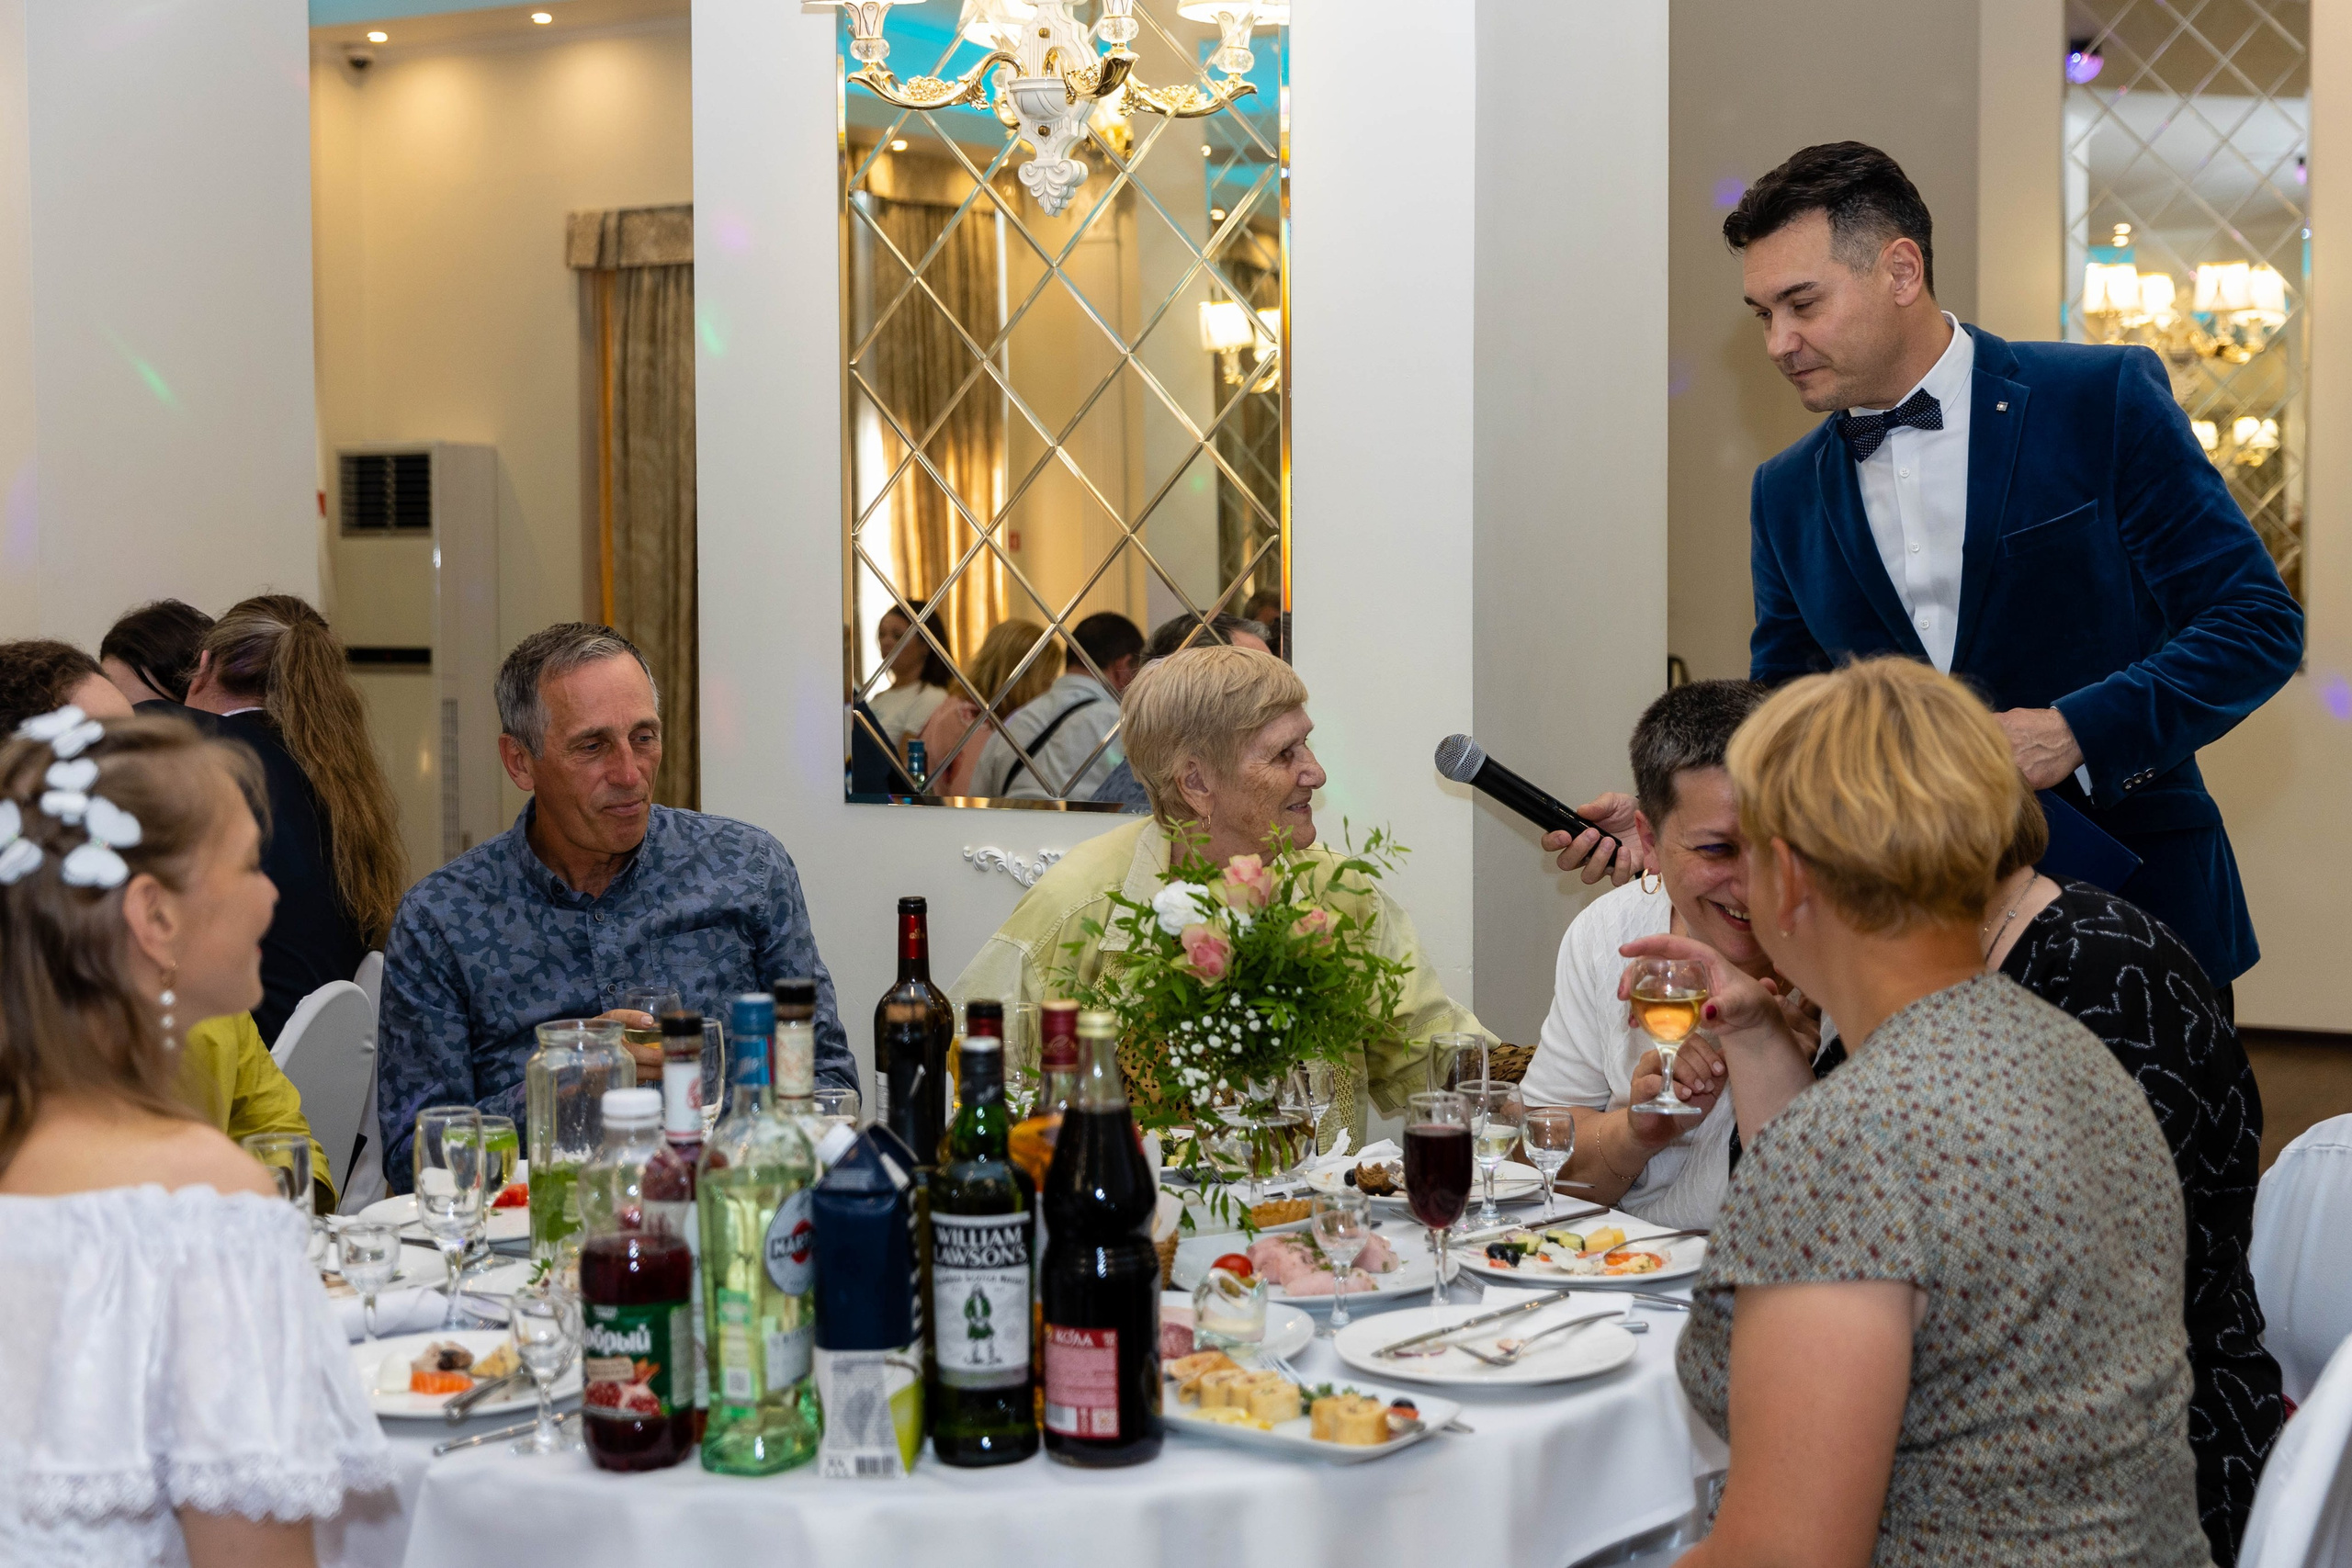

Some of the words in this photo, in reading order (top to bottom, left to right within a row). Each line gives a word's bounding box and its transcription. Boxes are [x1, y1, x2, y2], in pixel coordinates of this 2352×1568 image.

[772, 1233, 813, 1258] MART
[936, 1225, 1023, 1247] WILLIAM
[933, 1243, 1028, 1267] LAWSON'S
[582, 1323, 651, 1356] обрый
